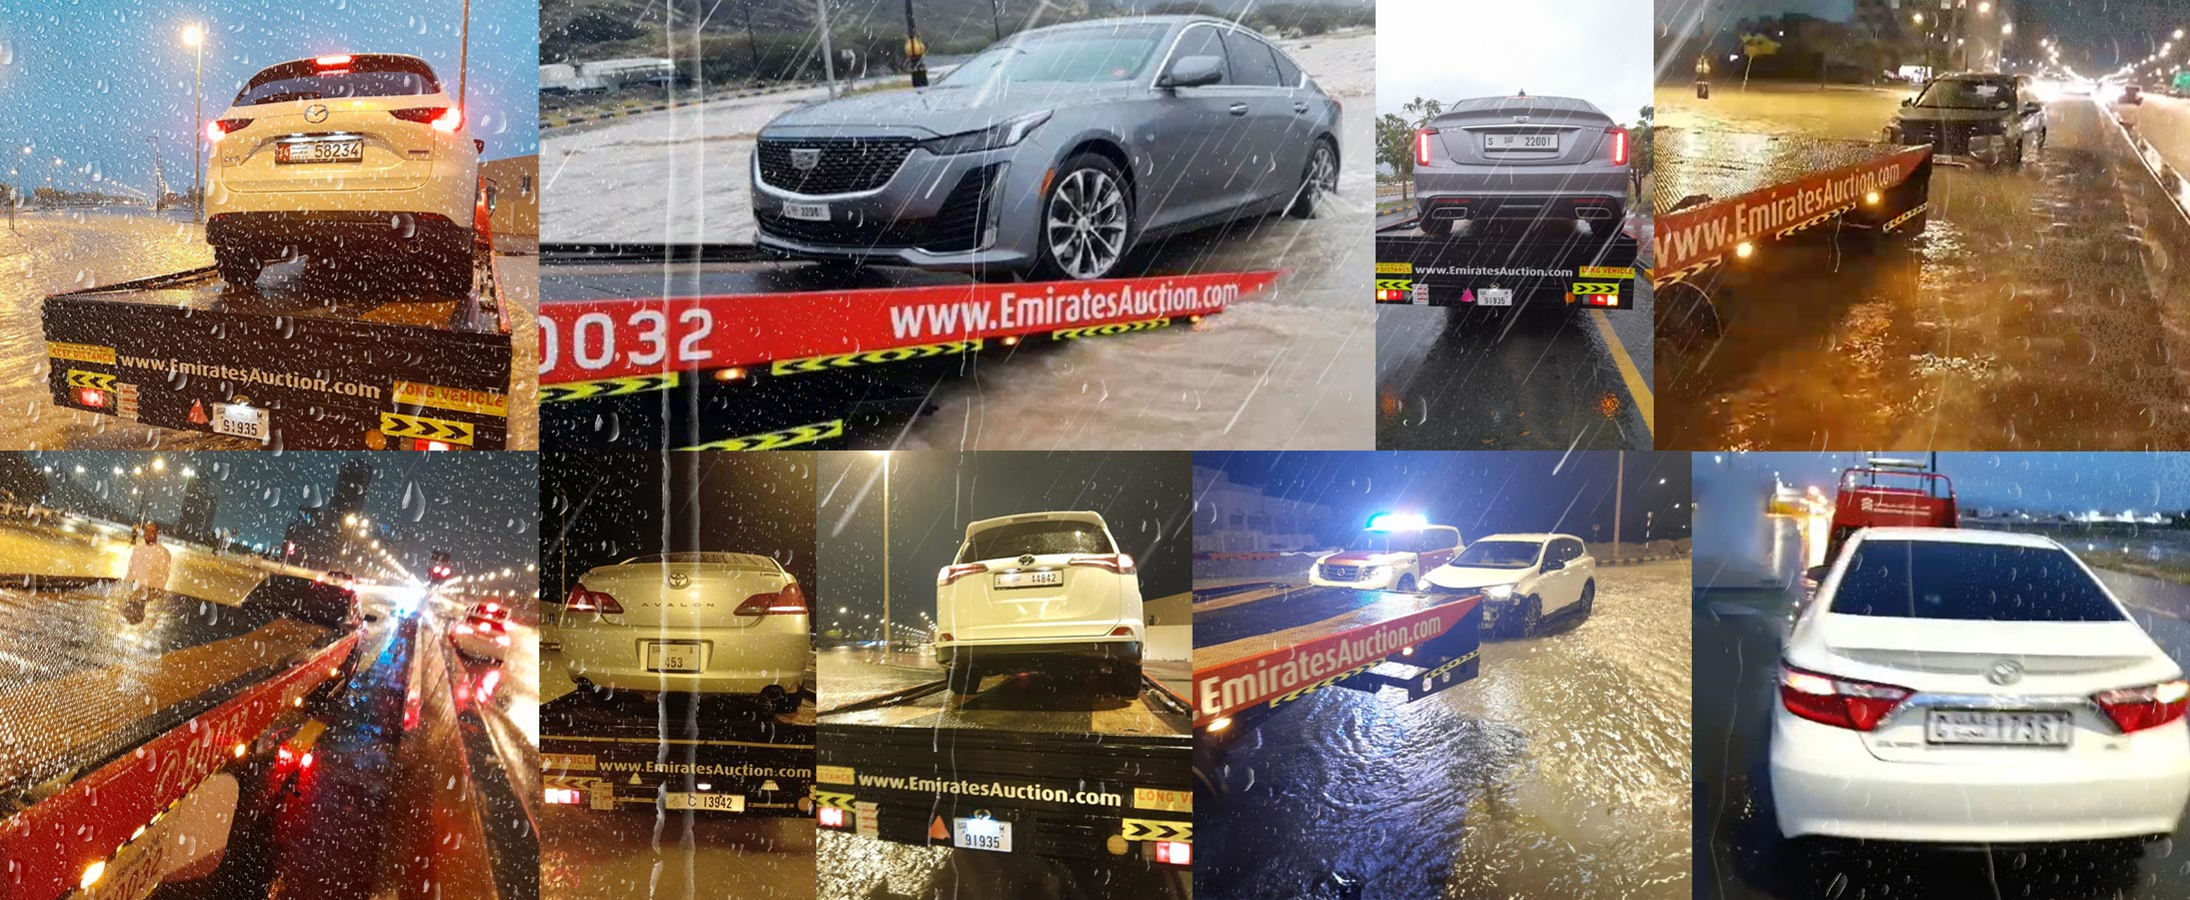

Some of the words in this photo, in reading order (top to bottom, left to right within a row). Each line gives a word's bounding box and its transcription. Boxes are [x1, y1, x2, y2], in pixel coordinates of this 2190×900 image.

[1488, 137, 1493, 146] S
[1525, 137, 1551, 146] 22001
[315, 143, 358, 158] 58234
[1415, 265, 1573, 277] www.EmiratesAuction.com
[1603, 267, 1633, 275] VEHICLE
[890, 281, 1239, 340] www.EmiratesAuction.com
[121, 355, 380, 399] www.EmiratesAuction.com
[398, 382, 434, 398] LONG
[441, 388, 503, 408] VEHICLE
[665, 657, 683, 668] 453
[600, 760, 812, 778] www.EmiratesAuction.com
[858, 774, 1122, 807] www.EmiratesAuction.com
[1138, 789, 1174, 802] LONG
[704, 796, 732, 809] 13942
[965, 834, 1000, 849] 91935
